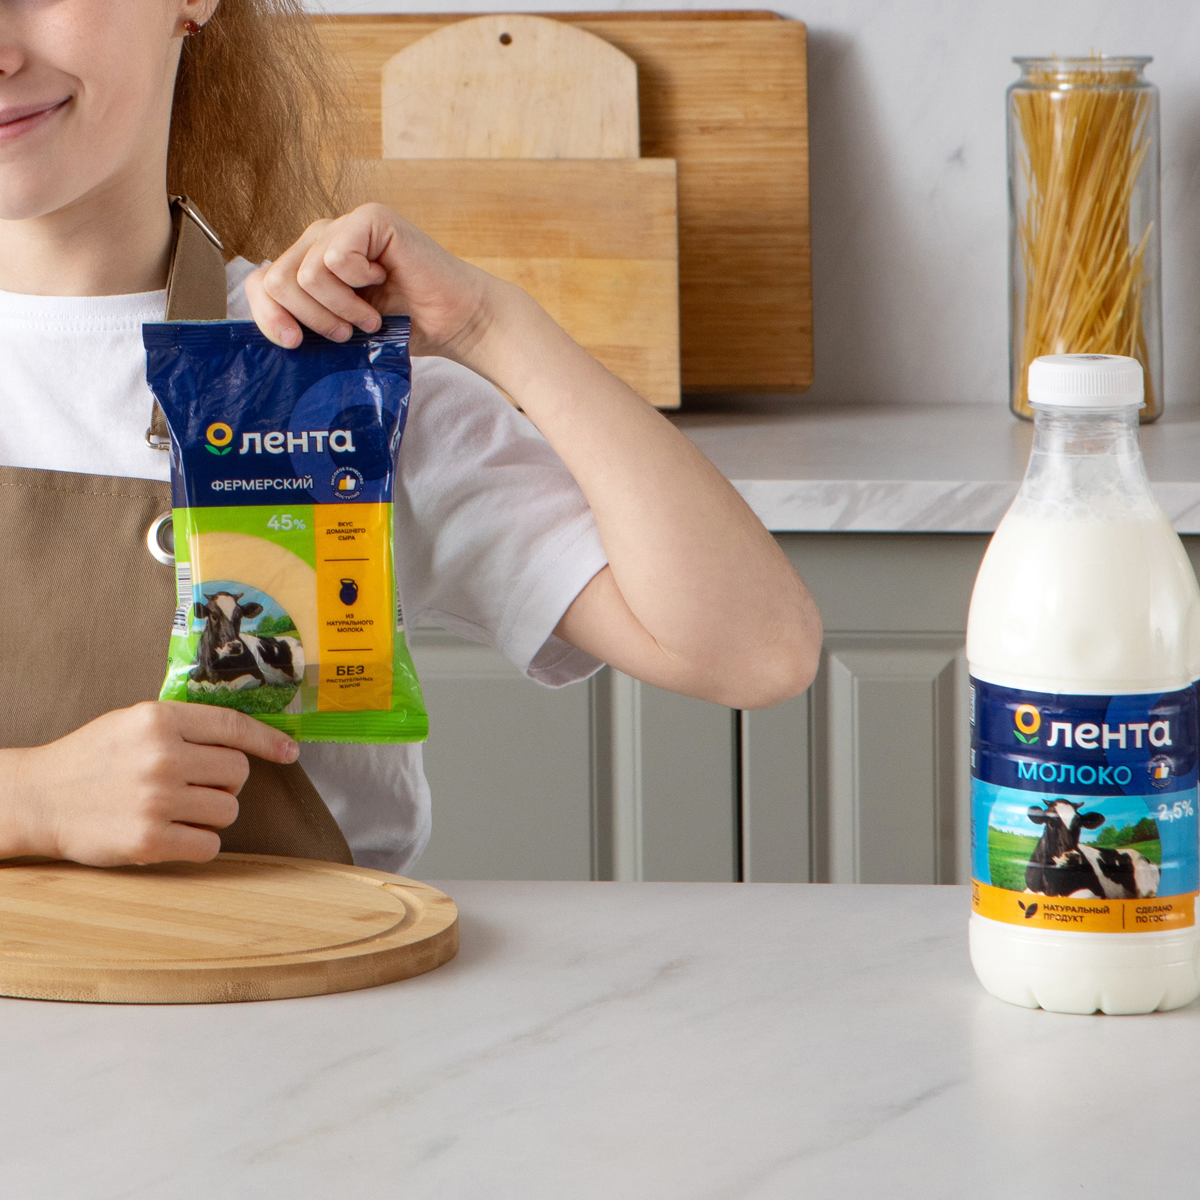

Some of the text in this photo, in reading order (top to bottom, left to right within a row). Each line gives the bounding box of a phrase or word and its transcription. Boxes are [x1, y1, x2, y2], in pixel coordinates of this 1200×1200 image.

[239, 429, 356, 455] лента
[211, 475, 314, 491] ФЕРМЕРСКИЙ
[346, 466, 364, 485] КАЧЕСТВО
[334, 491, 360, 500] ДОСТУПНО
[267, 514, 306, 531] 45%
[336, 665, 365, 676] БЕЗ
[1046, 720, 1173, 749] лента
[1017, 759, 1132, 785] МОЛОКО
[1157, 799, 1194, 823] 2,5%
[1043, 903, 1110, 914] НАТУРАЛЬНЫЙ
[1136, 903, 1173, 914] СДЕЛАНО
[1043, 912, 1085, 923] ПРОДУКТ
[1136, 913, 1168, 923] ПО ГОСТ
